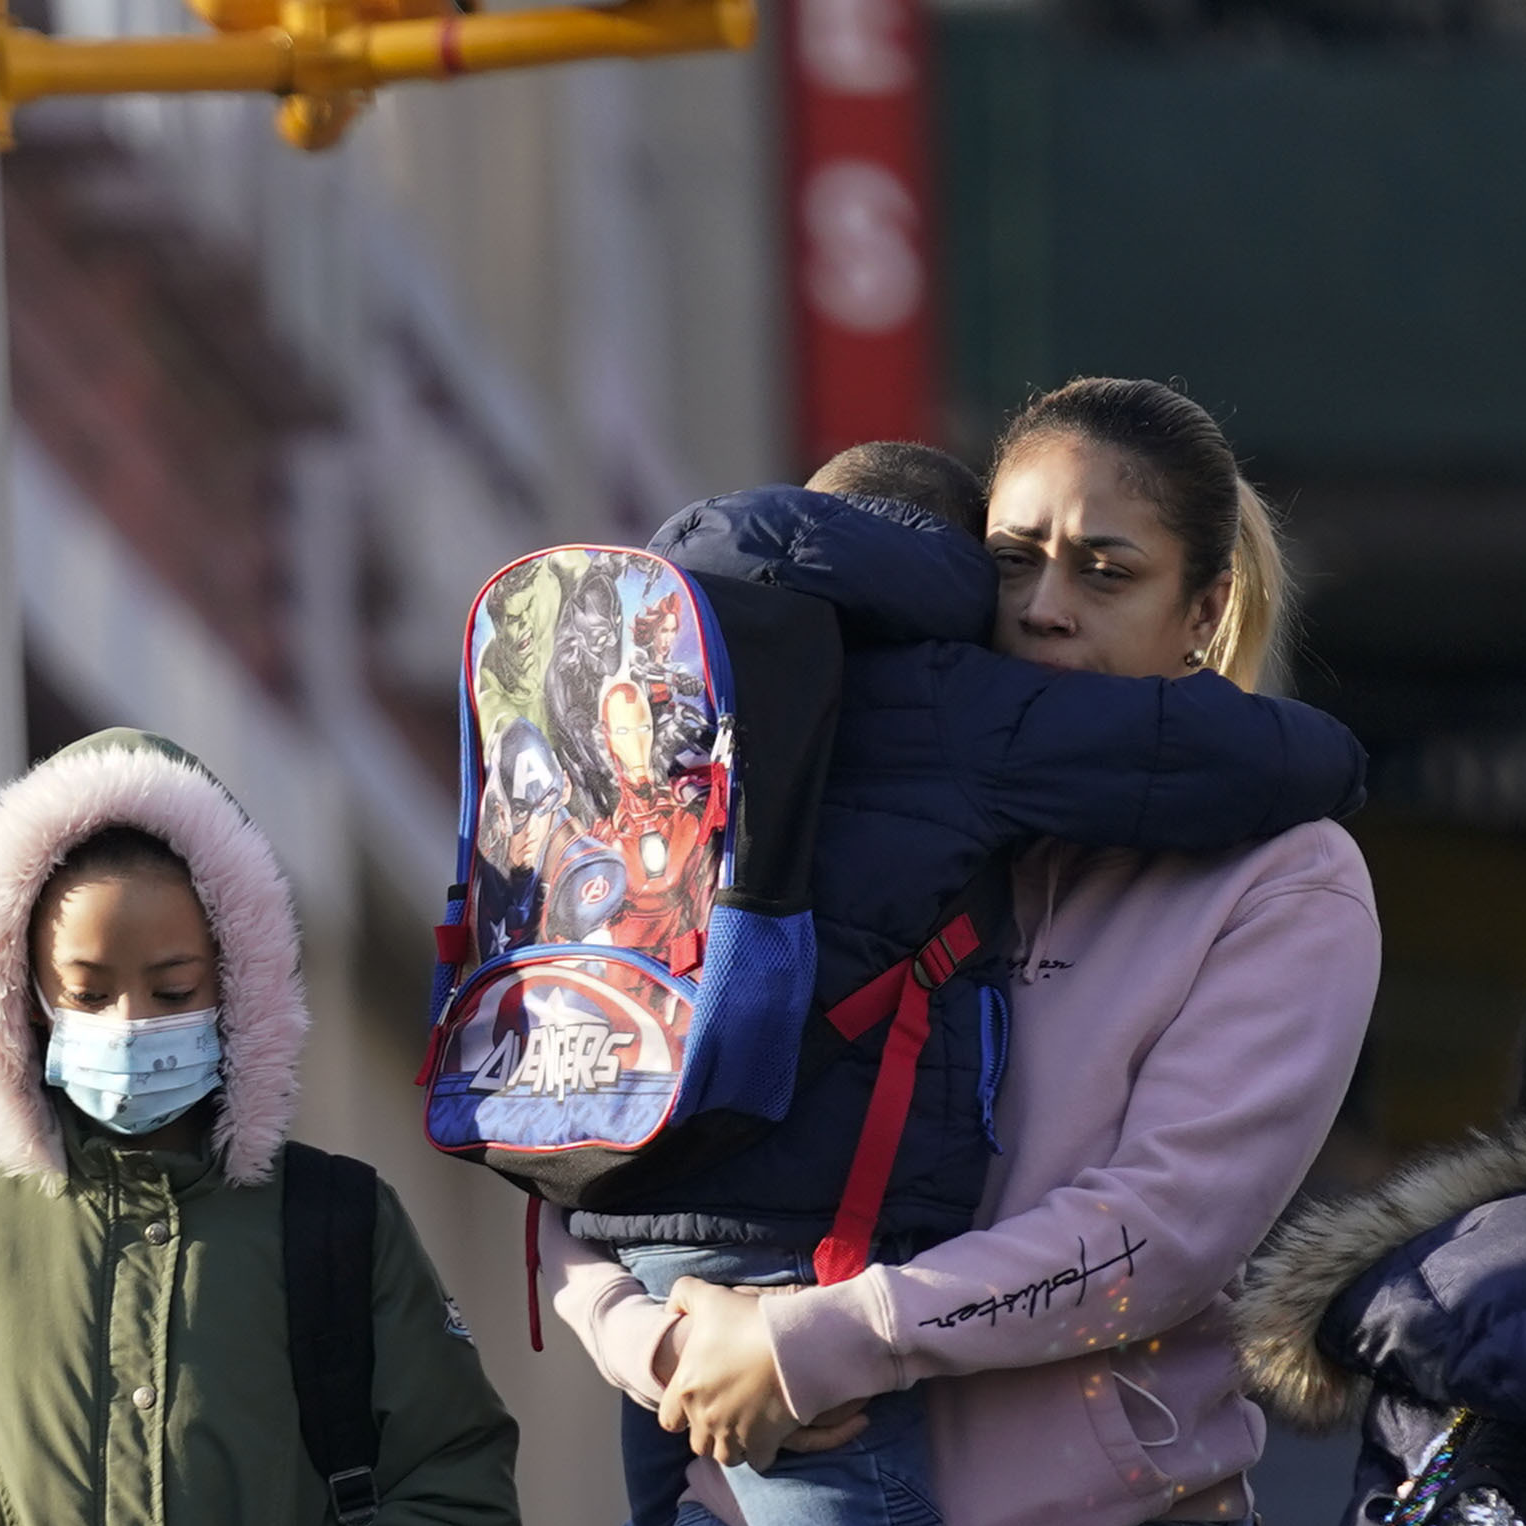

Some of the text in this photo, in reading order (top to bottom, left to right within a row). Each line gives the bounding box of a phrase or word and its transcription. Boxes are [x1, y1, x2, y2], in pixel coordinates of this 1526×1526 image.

[512, 748, 553, 800] A
[467, 1023, 636, 1104] AVENGERS
[918, 1224, 1148, 1336] Hollister
